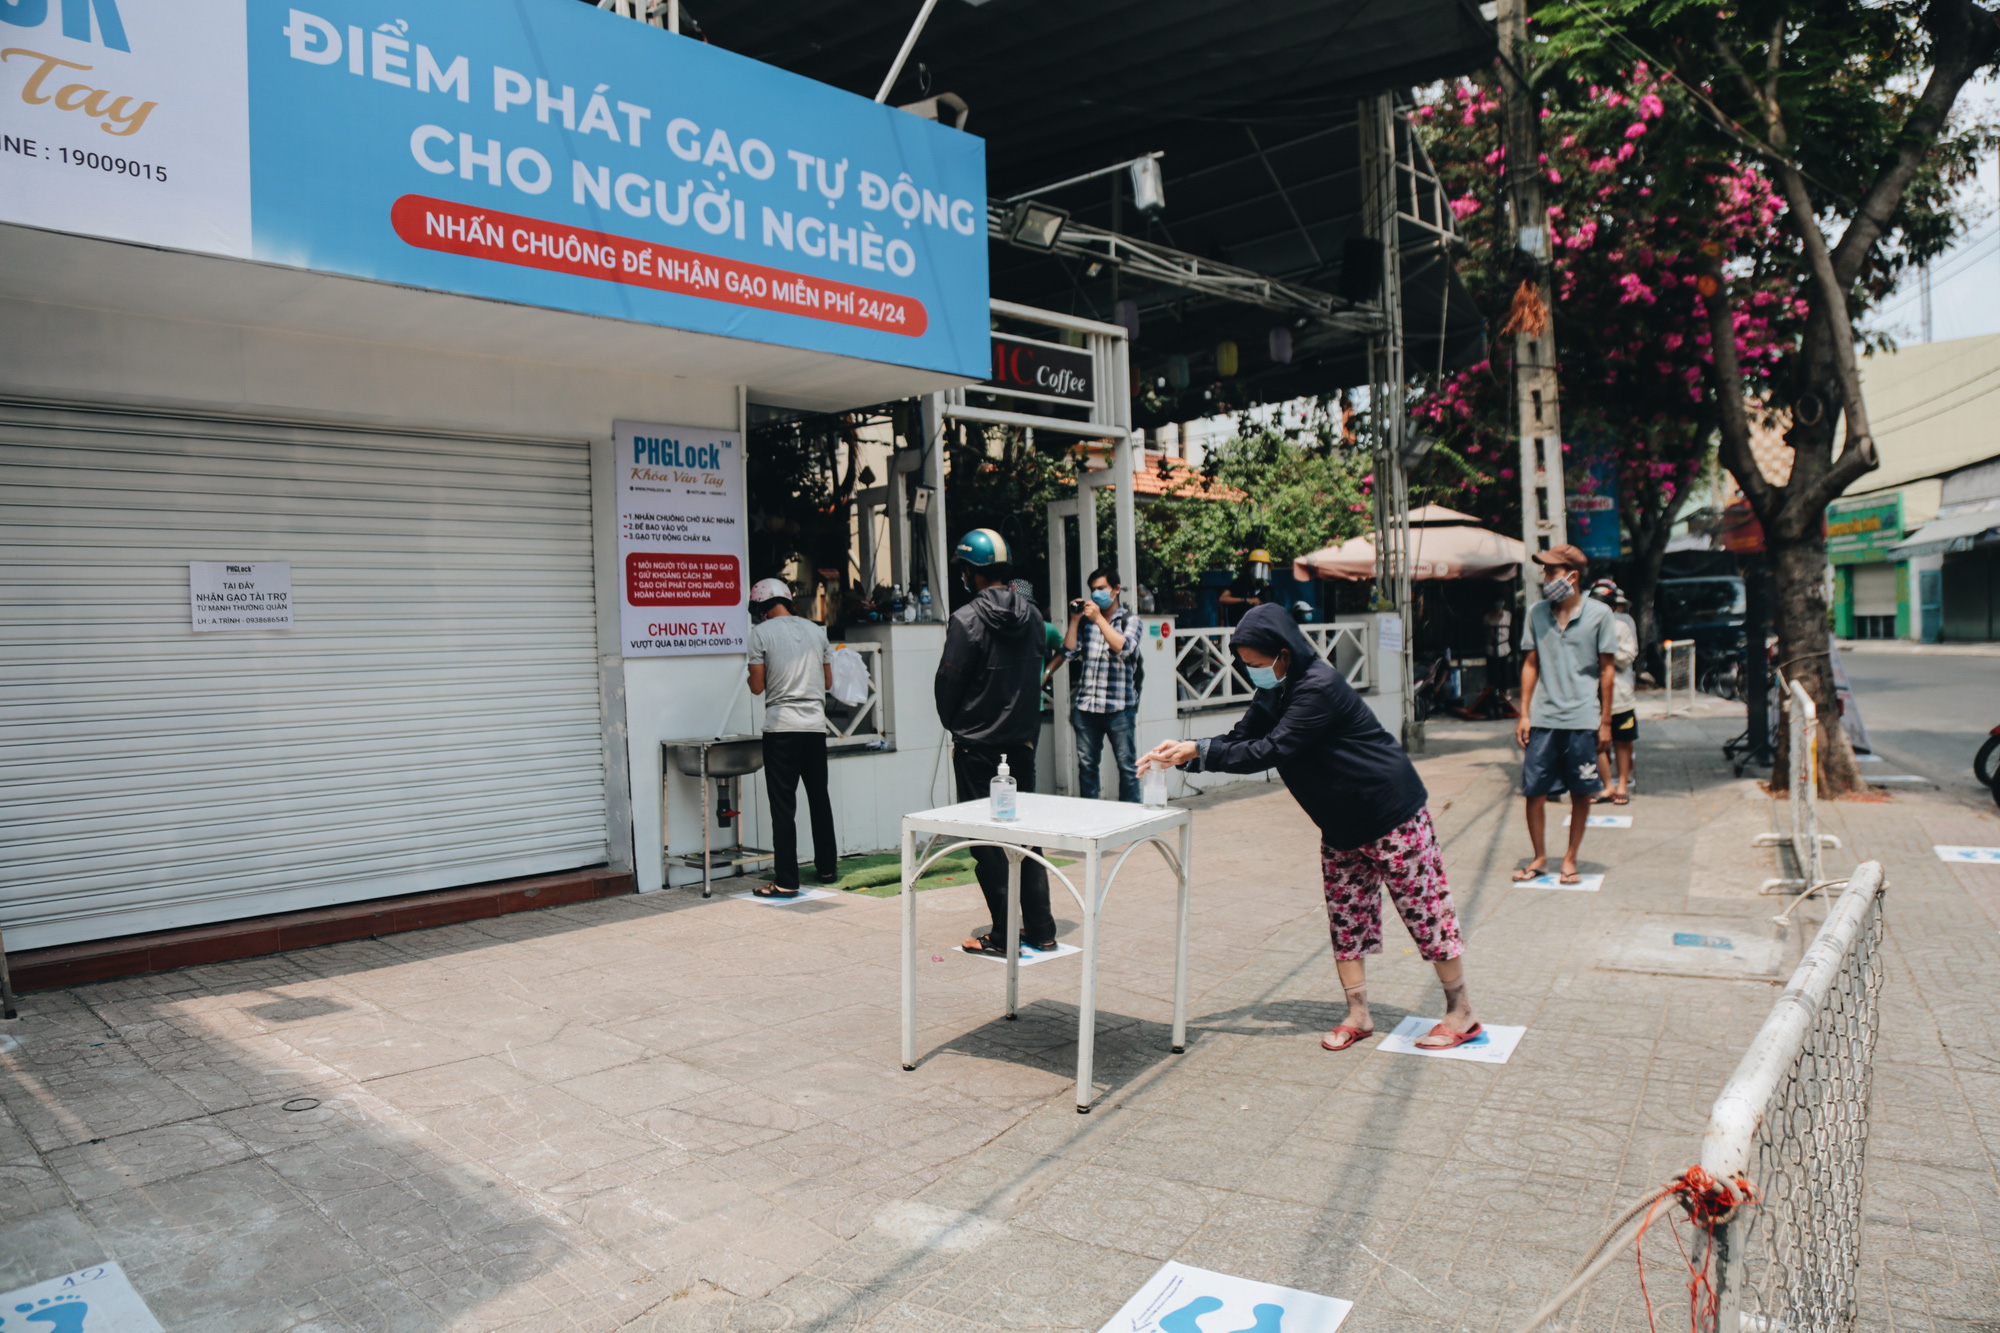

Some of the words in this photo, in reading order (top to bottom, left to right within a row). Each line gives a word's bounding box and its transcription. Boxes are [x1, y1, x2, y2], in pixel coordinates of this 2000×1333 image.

[1, 48, 159, 136] Tay
[283, 8, 470, 103] ĐIỂM
[493, 65, 651, 148] PHÁT
[666, 118, 775, 181] GẠO
[788, 149, 849, 209] TỰ
[858, 171, 975, 236] ĐỘNG
[59, 147, 168, 182] 19009015
[410, 124, 552, 195] CHO
[572, 160, 745, 240] NGƯỜI
[762, 206, 916, 277] NGHÈO
[426, 211, 504, 248] NHẤN
[512, 229, 616, 269] CHUÔNG
[621, 248, 653, 276] ĐỂ
[657, 256, 720, 290] NHẬN
[724, 271, 768, 300] GẠO
[772, 279, 820, 308] MIỄN
[824, 287, 855, 314] PHÍ
[858, 297, 907, 324] 24/24
[1036, 365, 1086, 394] Coffee
[634, 436, 720, 470] PHGLock
[631, 467, 669, 482] Khóa
[674, 471, 698, 483] Vân
[701, 473, 724, 488] Tay
[656, 514, 684, 522] CHUÔNG
[686, 515, 700, 523] CHỜ
[702, 515, 715, 523] XÁC
[716, 517, 734, 526] NHẬN
[663, 534, 681, 542] ĐỘNG
[226, 565, 251, 573] PHGLock
[653, 561, 675, 569] NGƯỜI
[683, 571, 701, 579] CÁCH
[223, 582, 236, 591] TẠI
[239, 581, 255, 589] ĐÂY
[196, 592, 224, 603] NHẬN
[227, 594, 247, 603] GẠO
[250, 592, 264, 601] TÀI
[267, 592, 287, 602] TRỢ
[208, 605, 230, 613] MẠNH
[648, 623, 698, 636] CHUNG
[701, 622, 725, 635] TAY
[631, 640, 652, 649] VƯỢT
[655, 640, 671, 648] QUA
[674, 640, 686, 648] ĐẠI
[689, 639, 706, 648] DỊCH
[709, 638, 743, 646] COVID-19
